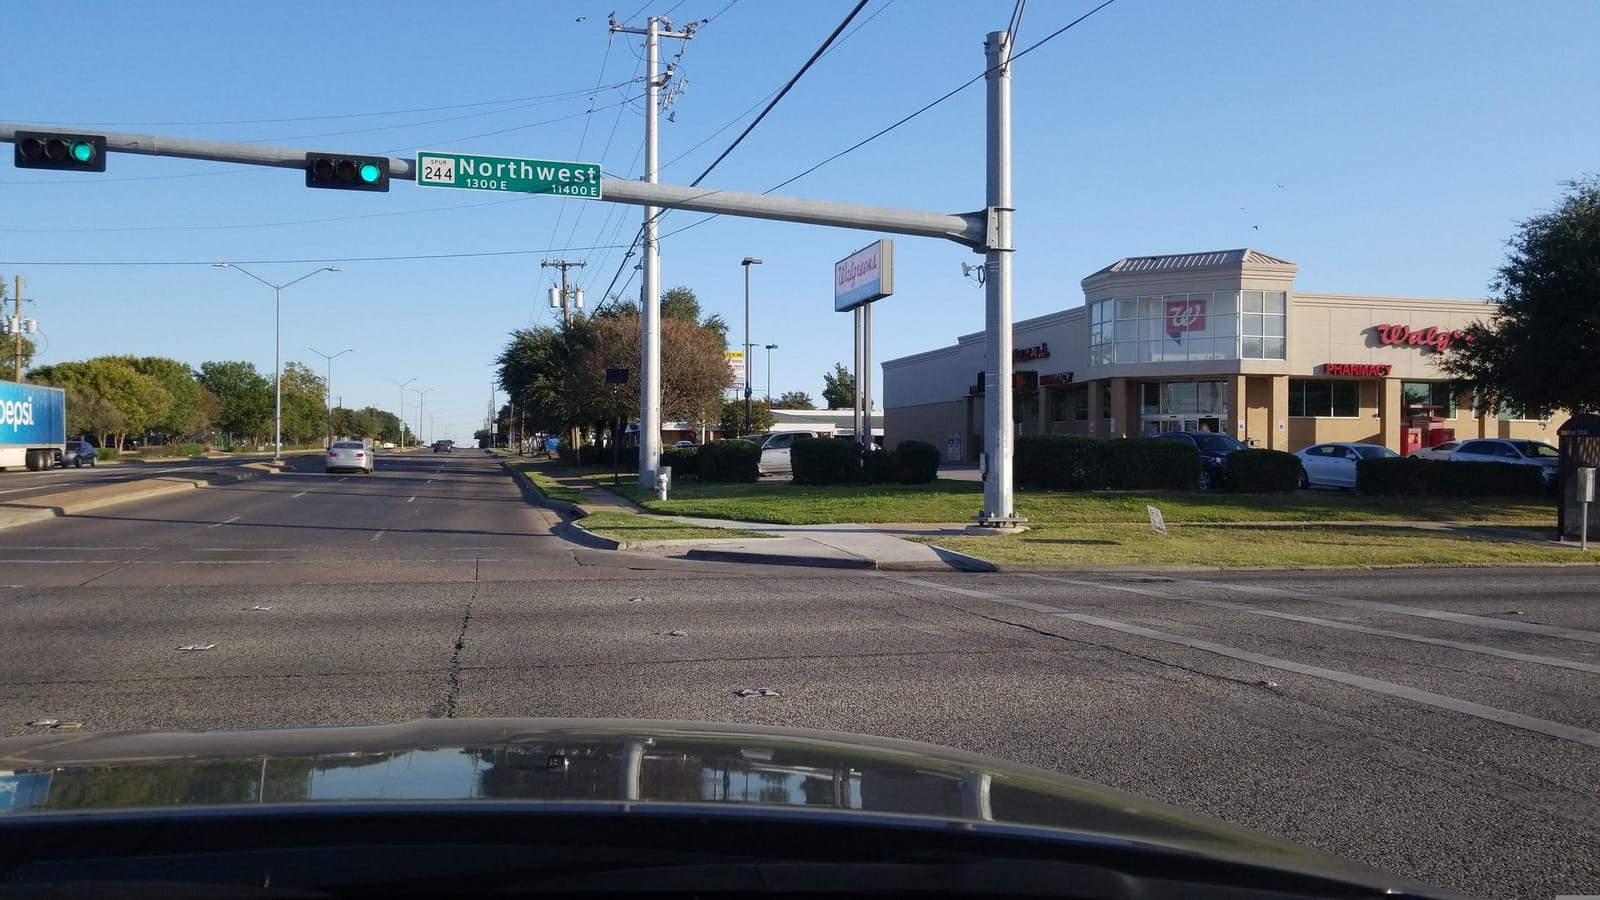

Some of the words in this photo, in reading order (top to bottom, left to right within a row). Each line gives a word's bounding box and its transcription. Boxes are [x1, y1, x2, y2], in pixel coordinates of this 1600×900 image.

[425, 166, 452, 180] 244
[459, 158, 596, 184] Northwest
[466, 178, 497, 189] 1300
[500, 180, 507, 189] E
[551, 184, 587, 195] 11400
[590, 187, 597, 196] E
[1325, 364, 1392, 376] PHARMACY
